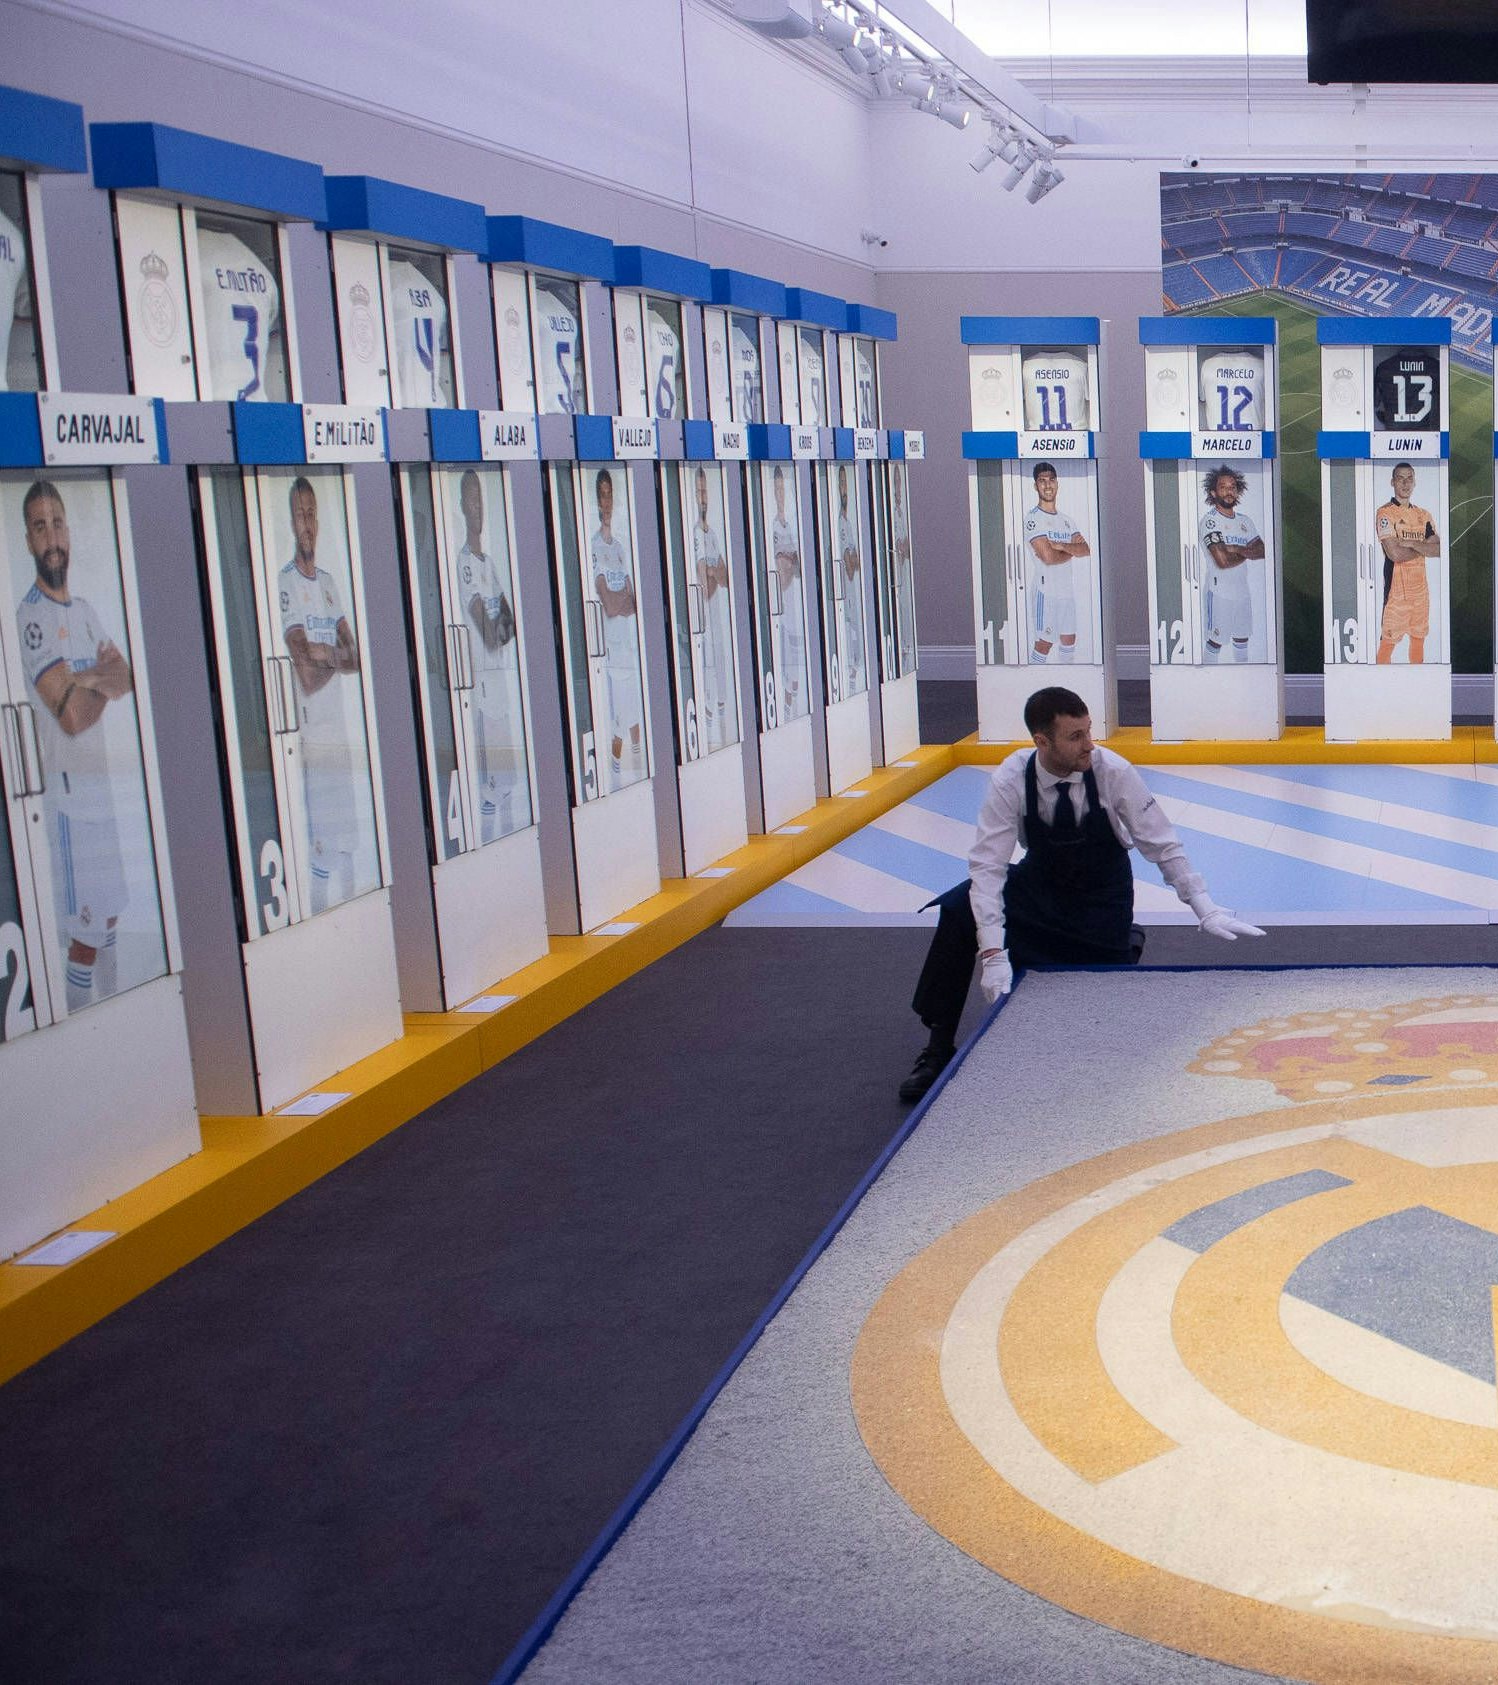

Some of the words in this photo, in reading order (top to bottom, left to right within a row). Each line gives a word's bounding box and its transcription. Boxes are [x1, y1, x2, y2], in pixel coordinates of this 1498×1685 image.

[1318, 266, 1400, 308] REAL
[1035, 368, 1070, 380] ASENSIO
[1216, 368, 1254, 380] MARCELO
[1399, 360, 1424, 372] LUNIN
[1036, 385, 1073, 431] 11
[1216, 385, 1254, 431] 12
[1393, 375, 1433, 423] 13
[56, 413, 145, 444] CARVAJAL
[493, 425, 527, 446] ALABA
[618, 428, 652, 447] VALLEJO
[1202, 438, 1252, 451] MARCELO
[1158, 619, 1185, 665] 12
[1332, 618, 1359, 664] 13
[765, 671, 778, 730] 8
[686, 697, 700, 761] 6
[260, 839, 291, 933] 3
